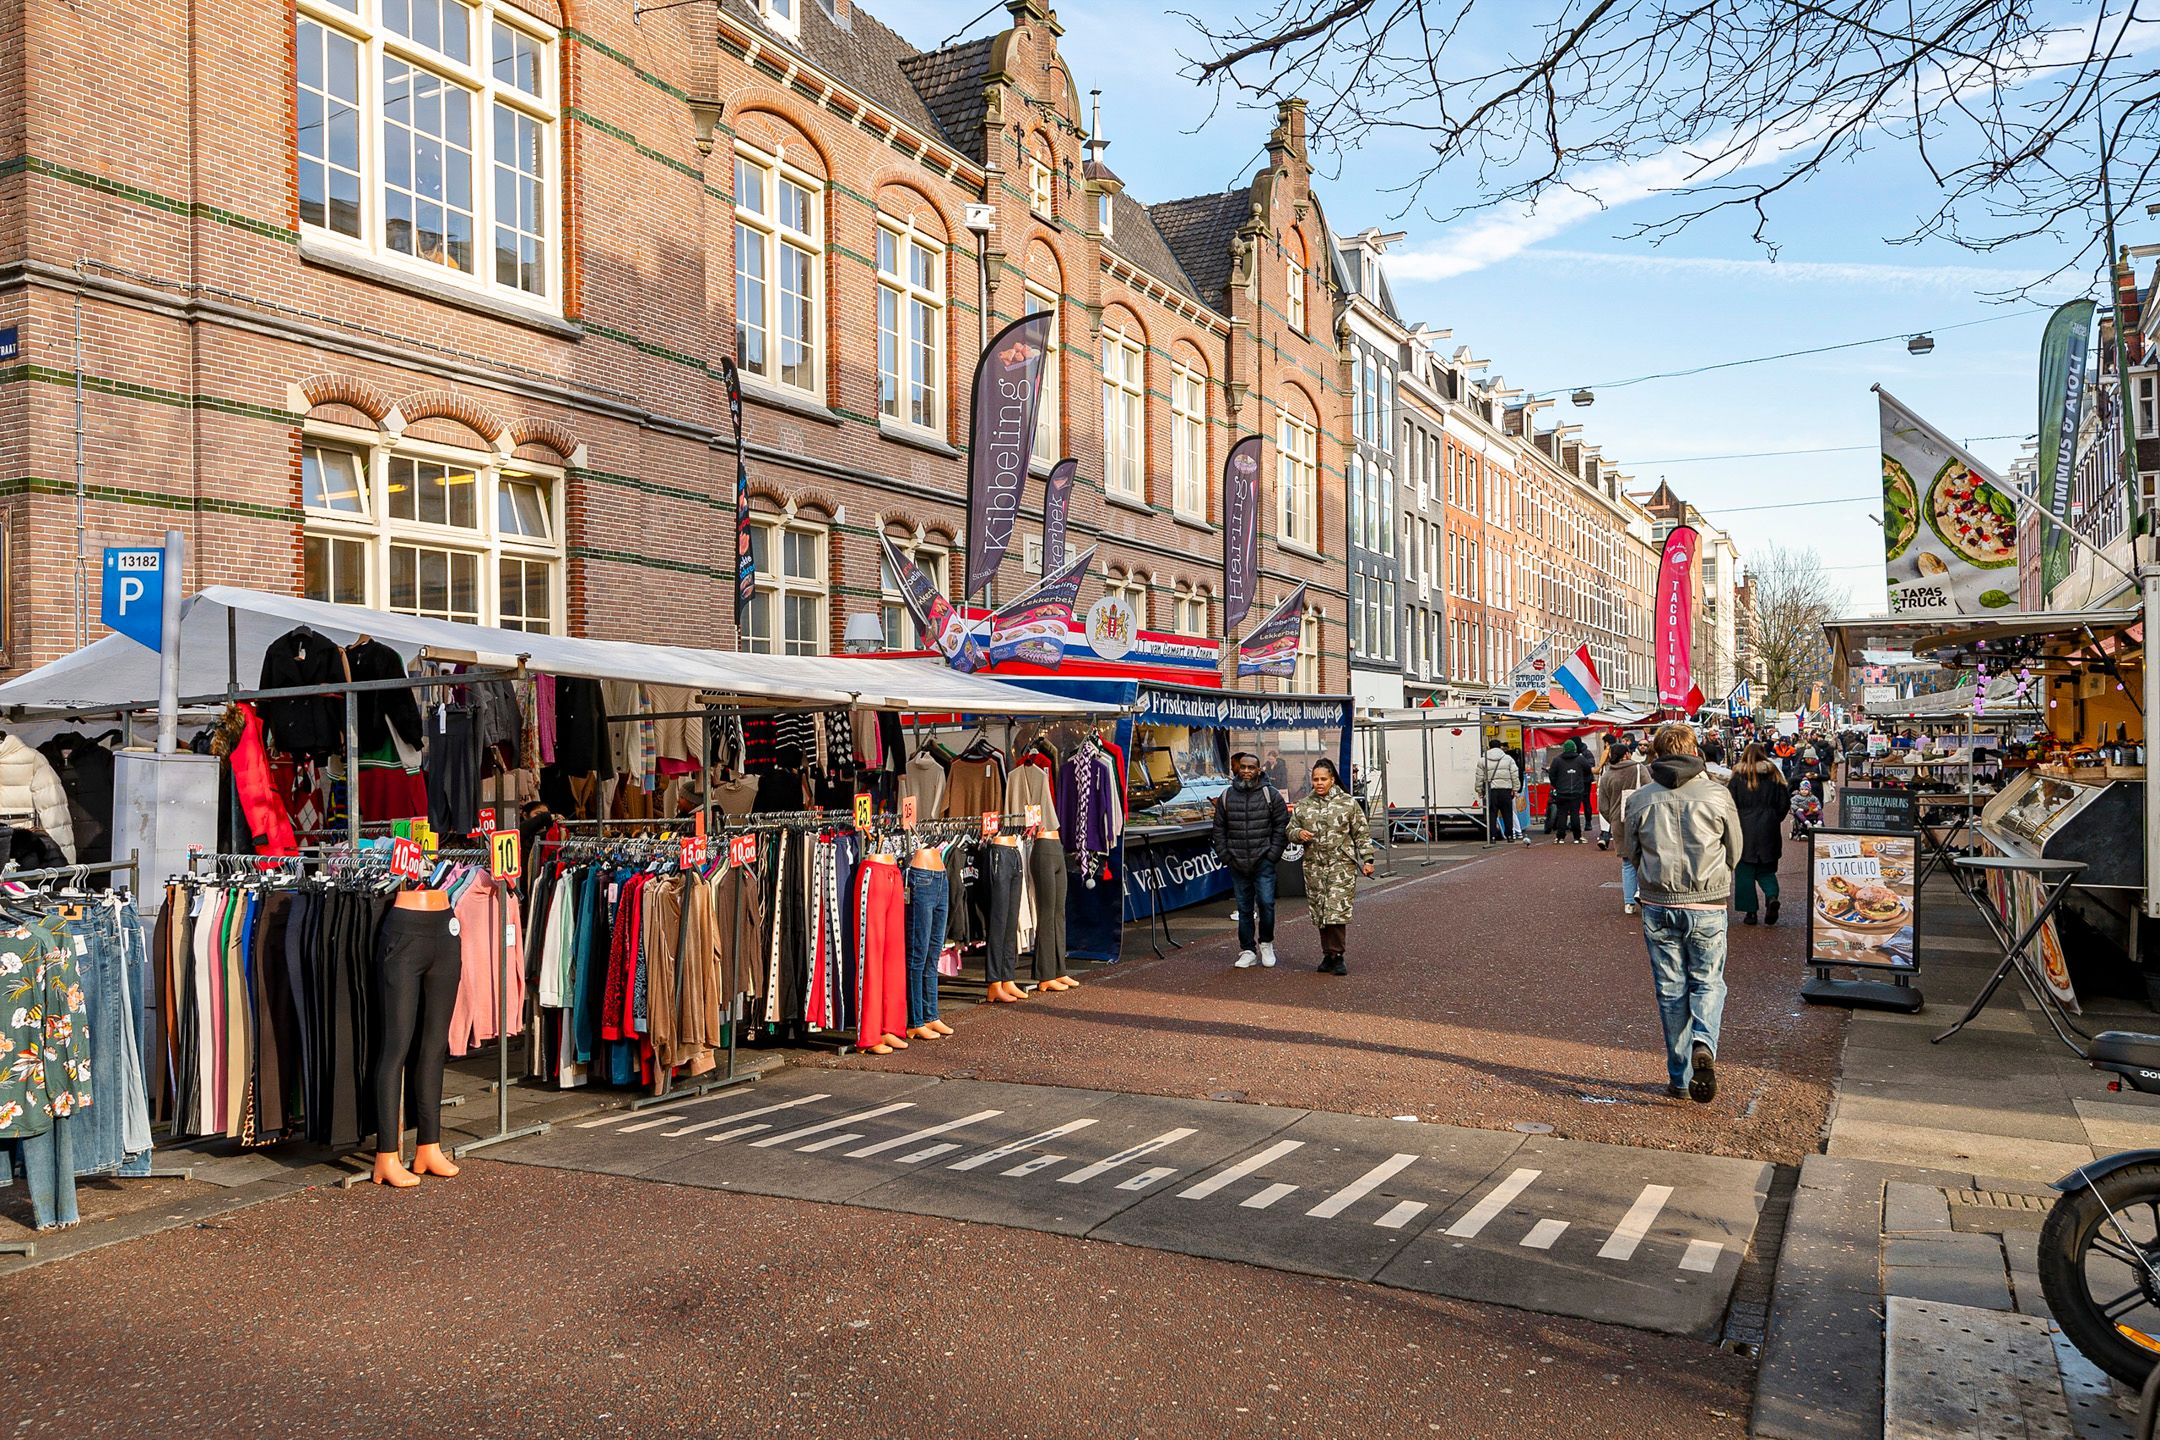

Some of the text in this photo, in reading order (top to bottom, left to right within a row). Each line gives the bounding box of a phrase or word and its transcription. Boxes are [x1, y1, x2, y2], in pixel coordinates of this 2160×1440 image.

[0, 344, 16, 356] RAAT
[2065, 354, 2082, 414] AIOLI
[984, 378, 1031, 553] Kibbeling
[1047, 494, 1066, 580] kkerbek
[1229, 475, 1248, 604] Haring
[121, 556, 157, 567] 13182
[119, 577, 144, 616] P
[1901, 587, 1943, 598] TAPAS
[1021, 595, 1074, 607] Lekkerbek
[1669, 580, 1679, 625] TACO
[1900, 597, 1948, 608] TRUCK
[1260, 630, 1299, 640] Lekkerbek
[1151, 644, 1162, 656] van
[1668, 631, 1677, 688] LINDO
[1515, 674, 1546, 682] STROOP
[1152, 691, 1335, 724] Frisdranken Haring Belegde broodjes
[1831, 842, 1857, 856] SWEET
[1132, 867, 1167, 892] van
[1164, 847, 1228, 884] Geme
[1820, 860, 1877, 876] PISTACHIO
